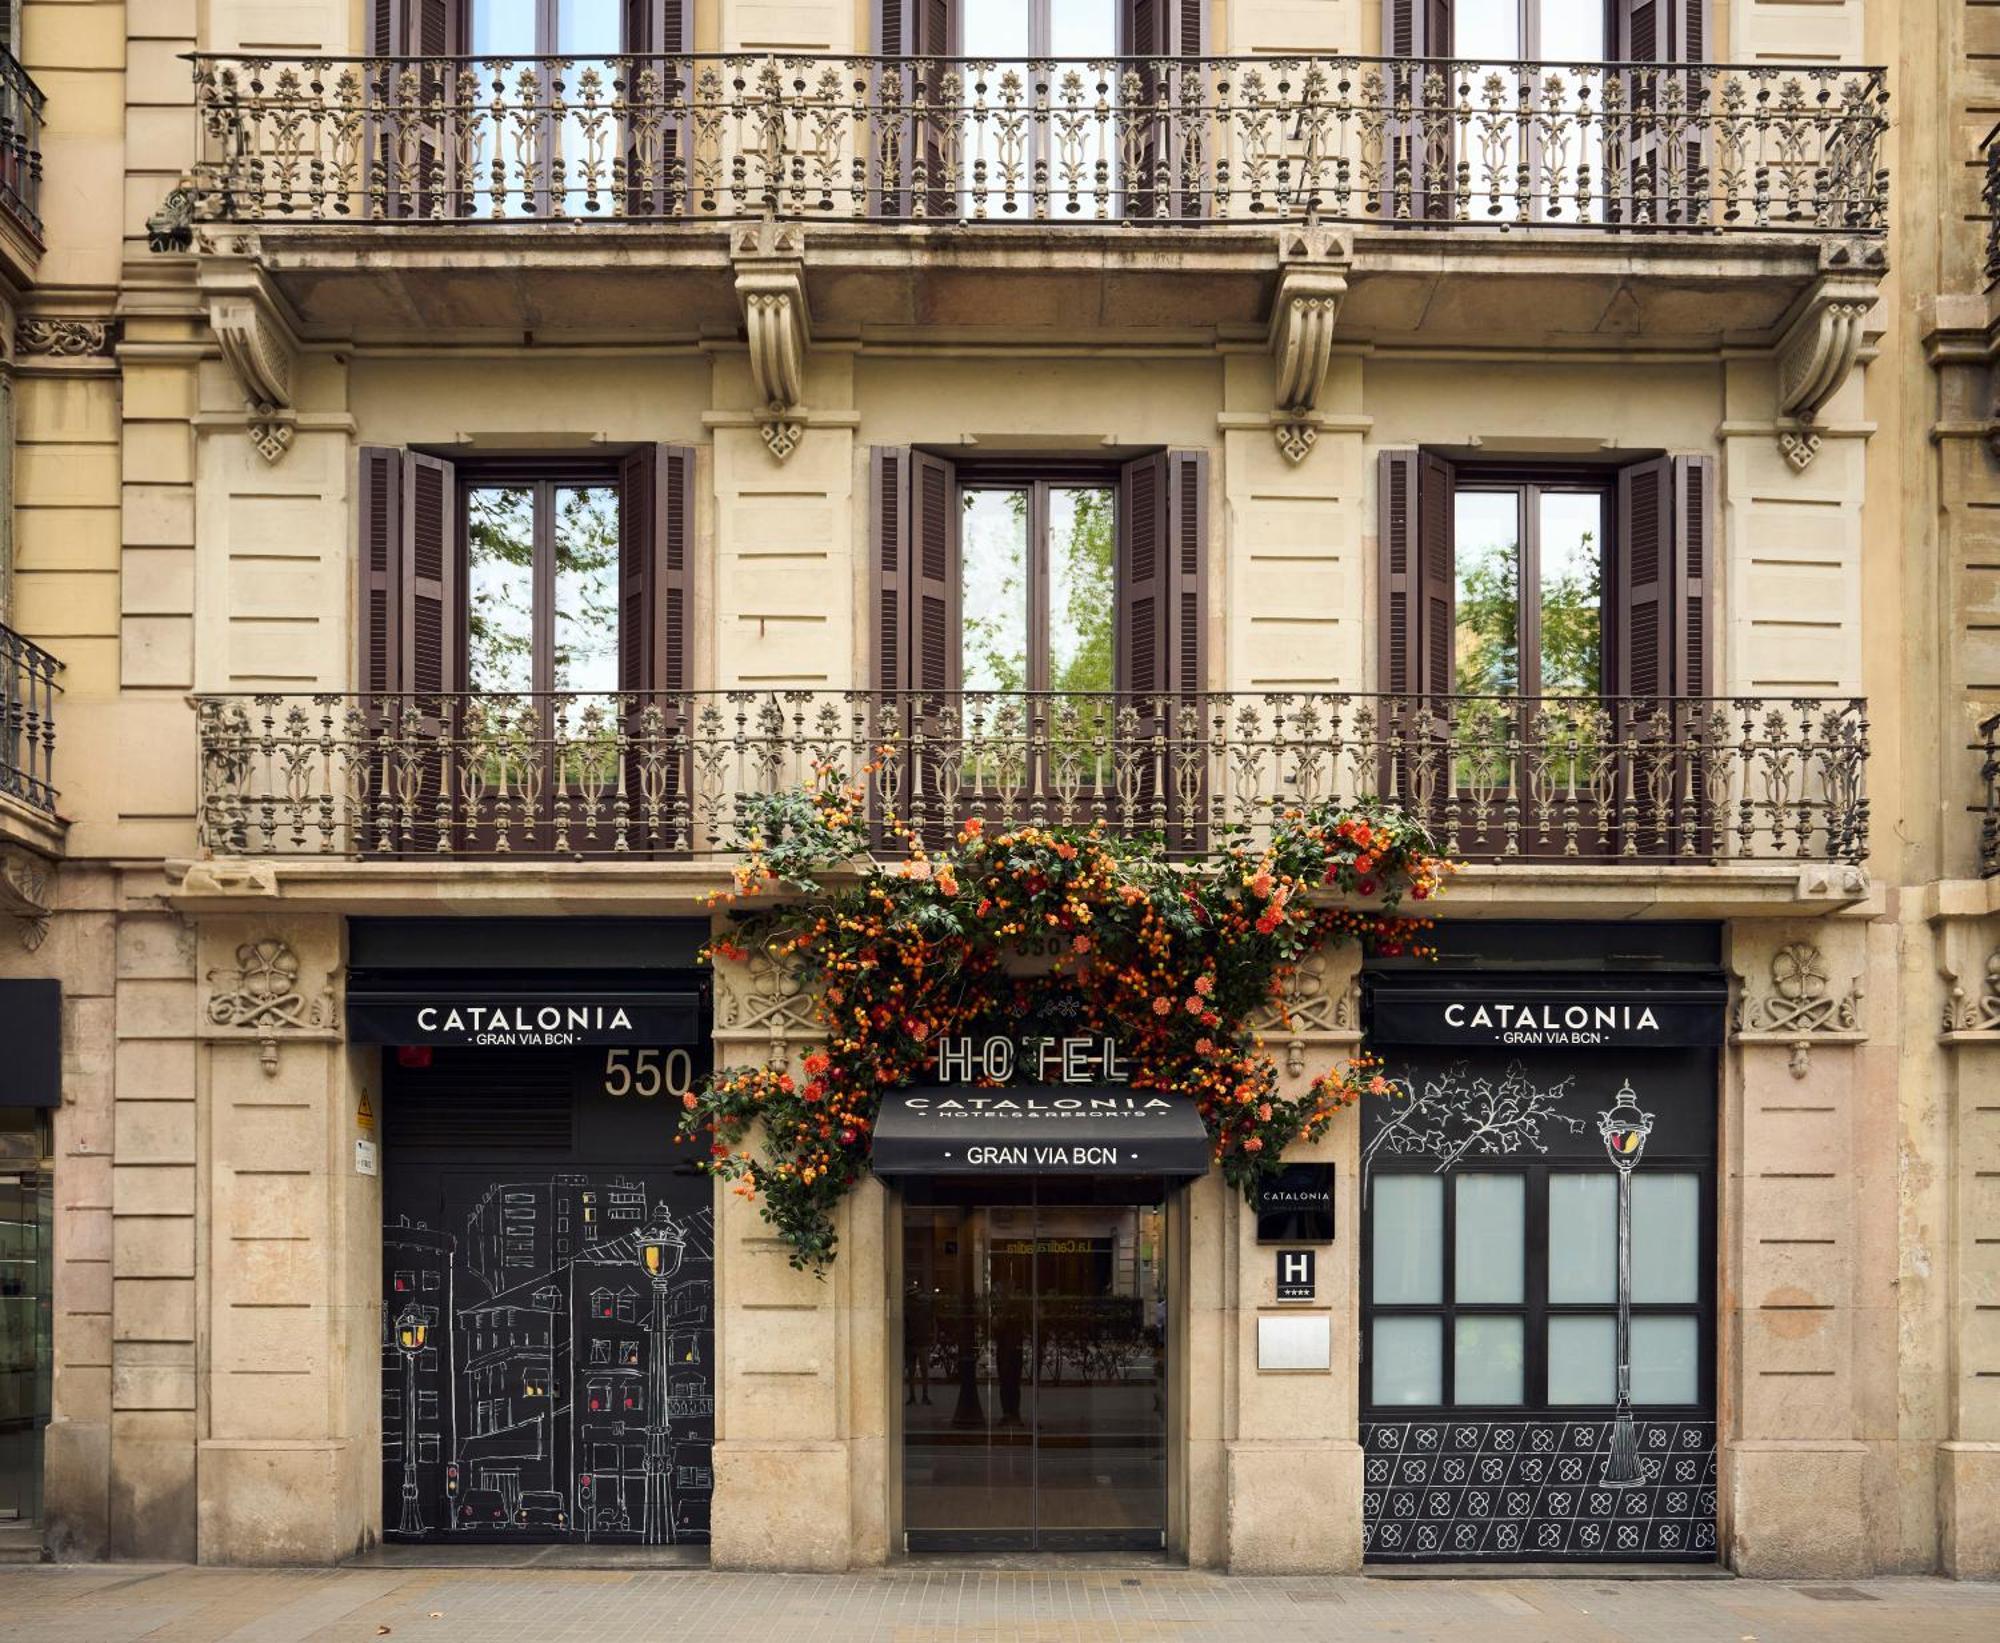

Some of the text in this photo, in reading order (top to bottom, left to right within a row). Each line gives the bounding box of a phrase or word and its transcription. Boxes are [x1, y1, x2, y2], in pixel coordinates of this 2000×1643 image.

[417, 1006, 633, 1032] CATALONIA
[1444, 1003, 1660, 1031] CATALONIA
[476, 1033, 574, 1046] GRAN VIA BCN
[1503, 1031, 1601, 1045] GRAN VIA BCN
[938, 1036, 1129, 1083] HOTEL
[604, 1048, 692, 1097] 550
[904, 1097, 1173, 1110] CATALONIA
[966, 1147, 1117, 1165] GRAN VIA BCN
[1263, 1191, 1330, 1201] CATALONIA
[1284, 1254, 1308, 1283] H
